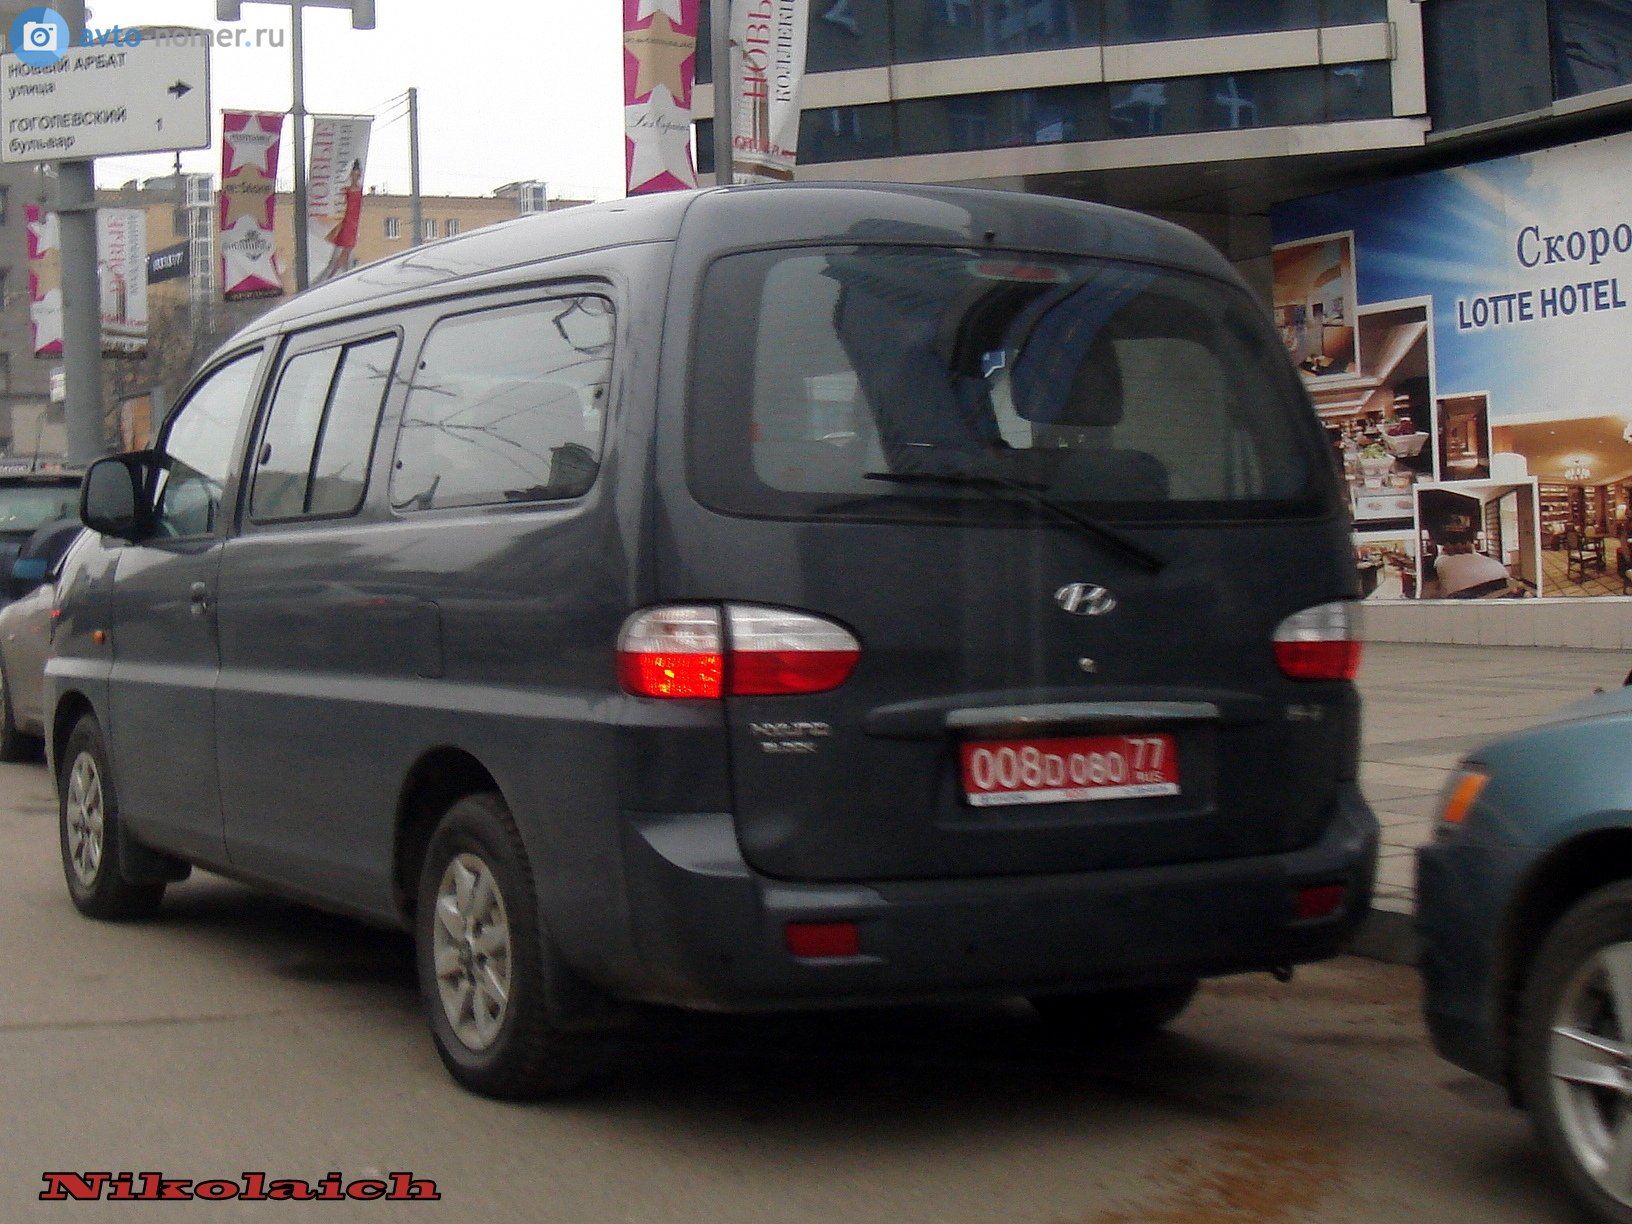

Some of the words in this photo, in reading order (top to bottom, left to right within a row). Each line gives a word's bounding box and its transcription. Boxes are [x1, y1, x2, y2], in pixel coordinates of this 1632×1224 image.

[73, 51, 128, 72] АРБАТ
[8, 80, 57, 101] улица
[9, 104, 128, 134] ГОГОЛЕВСКИЙ
[155, 117, 164, 133] 1
[8, 134, 76, 155] бульвар
[1458, 291, 1534, 330] LOTTE
[1540, 278, 1627, 319] HOTEL
